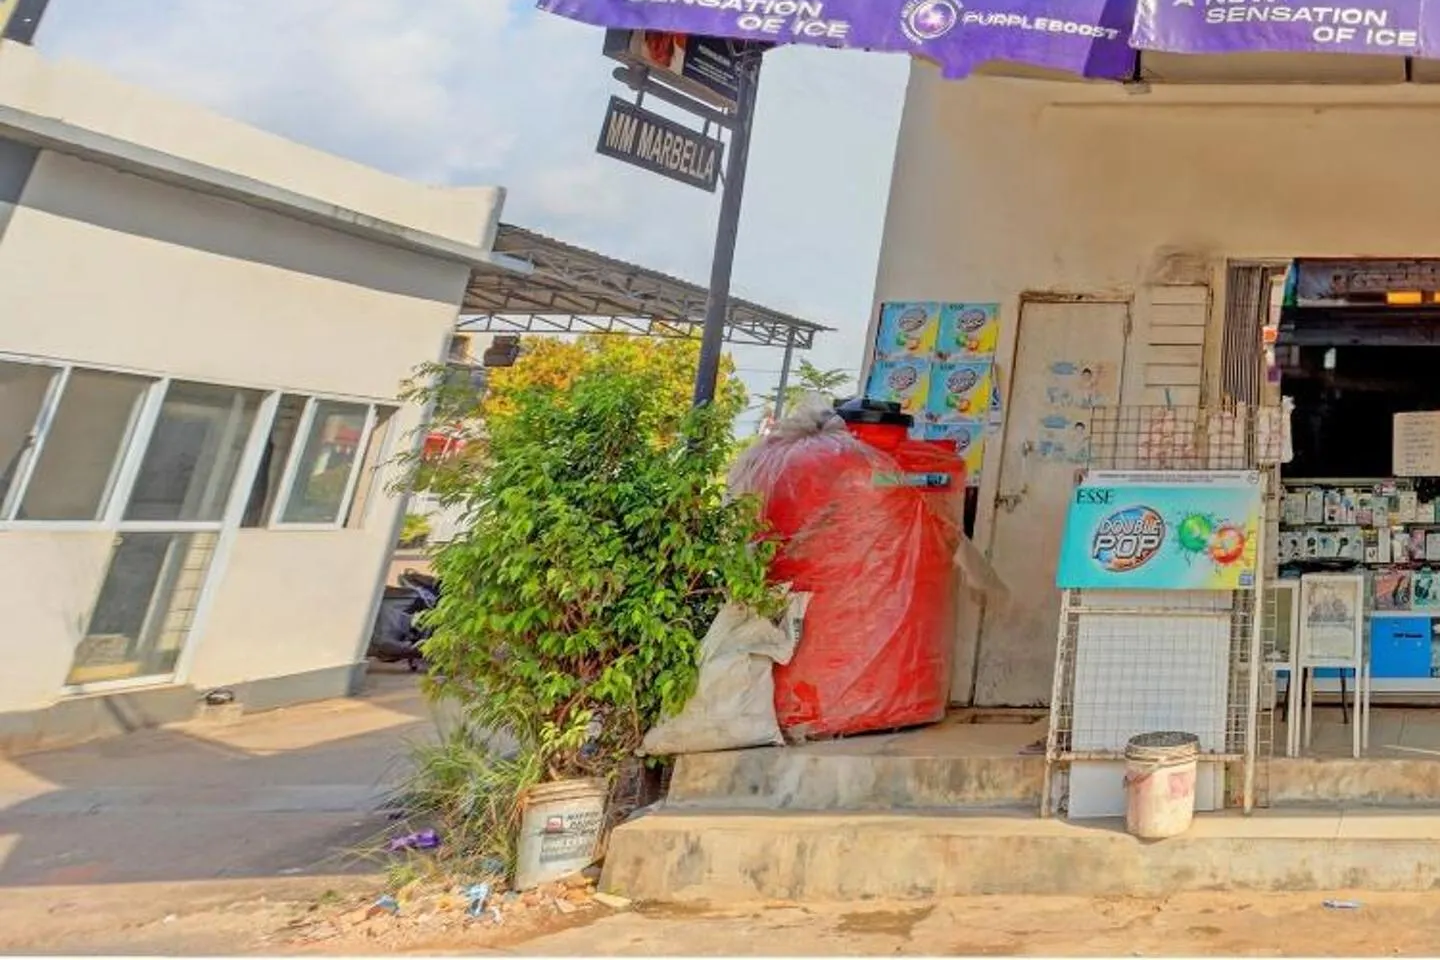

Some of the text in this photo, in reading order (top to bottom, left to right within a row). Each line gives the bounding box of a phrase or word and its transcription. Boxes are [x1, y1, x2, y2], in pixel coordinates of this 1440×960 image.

[1206, 7, 1387, 26] SENSATION
[792, 18, 852, 39] ICE
[1312, 26, 1418, 47] OF ICE
[605, 111, 716, 183] MM MARBELLA
[1076, 489, 1115, 504] ESSE
[1099, 519, 1160, 535] DOUBLE
[1093, 535, 1160, 558] POP
